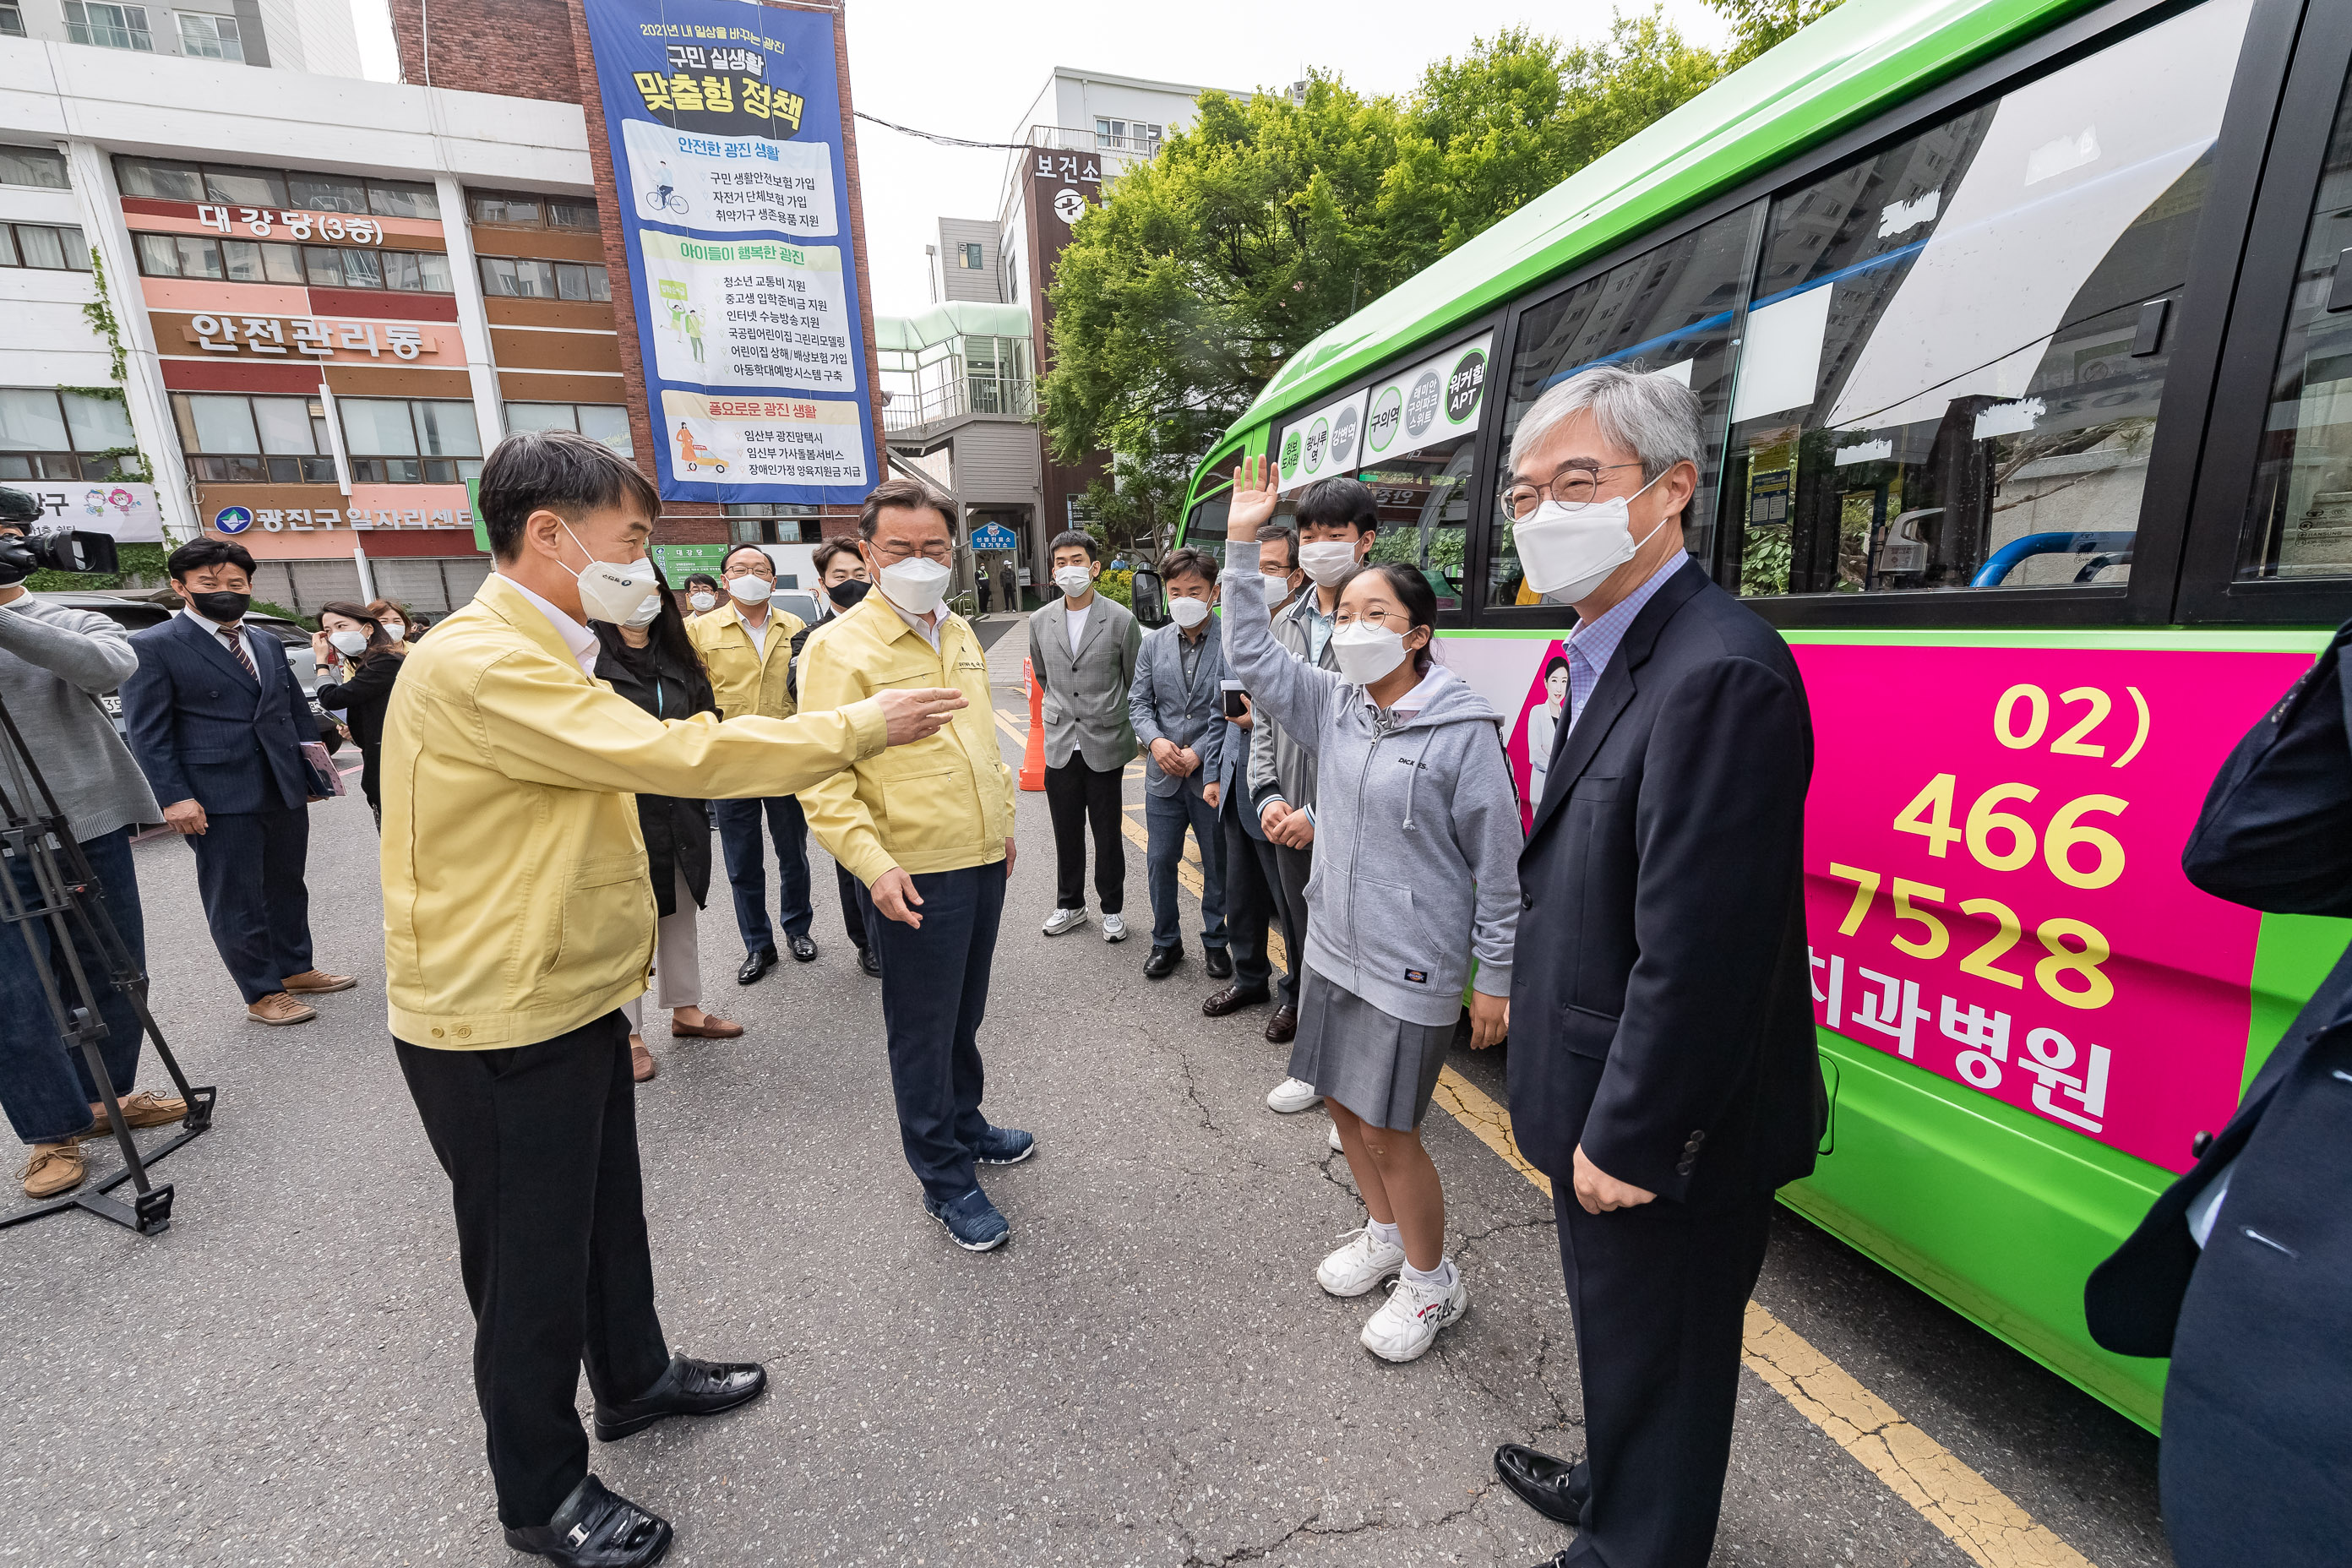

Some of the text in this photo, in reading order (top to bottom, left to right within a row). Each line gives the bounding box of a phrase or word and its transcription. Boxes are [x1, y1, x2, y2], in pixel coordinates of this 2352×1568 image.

[640, 24, 785, 55] 2021년 내 일상을 바꾸는 광진
[667, 46, 765, 76] 구민 실생활
[634, 72, 803, 130] 맞춤형 정책
[678, 137, 721, 157] 안전한
[725, 143, 752, 158] 광진
[1035, 155, 1102, 184] 보건소
[710, 172, 815, 191] 구민 생활안전보험 가입
[713, 190, 807, 209] 자전거 단체보험 가입
[716, 209, 819, 227] 취약가구 생존용품 지원
[680, 242, 805, 265] 아이들이 행복한 광진
[723, 275, 806, 292] 청소년 교통비 지원
[726, 293, 828, 313] 중고생 입학준비금 지원
[727, 310, 820, 329] 인터넷 수능방송 지원
[192, 315, 422, 360] 안전관리동
[728, 327, 845, 348] 국공립어린이집 그린리모델링
[731, 346, 768, 358] 어린이집
[830, 353, 847, 365] 가입
[734, 363, 843, 382] 아동학대예방시스템 구축
[1449, 362, 1485, 394] 워커힐
[1413, 378, 1437, 400] 래미안
[710, 401, 817, 419] 풍요로운 광진 생활
[1408, 394, 1438, 416] 구의파크
[1450, 388, 1477, 412] APT
[1371, 405, 1401, 433] 구의역
[1409, 411, 1431, 429] 스위트
[744, 430, 823, 444] 임산부 광진맘택시
[1307, 431, 1326, 451] 광나루
[1333, 422, 1356, 446] 강변역
[747, 447, 845, 460] 임신부 가사돌봄서비스
[1287, 439, 1298, 455] 정보
[1311, 449, 1318, 463] 역
[749, 464, 861, 477] 장애인가정 양육지원금 지급
[1282, 453, 1298, 469] 도서관
[256, 508, 342, 533] 광진구
[1994, 683, 2151, 768] 02)
[1398, 757, 1427, 770] DICKES
[1892, 772, 2130, 890] 466
[1829, 861, 2115, 1010] 7528
